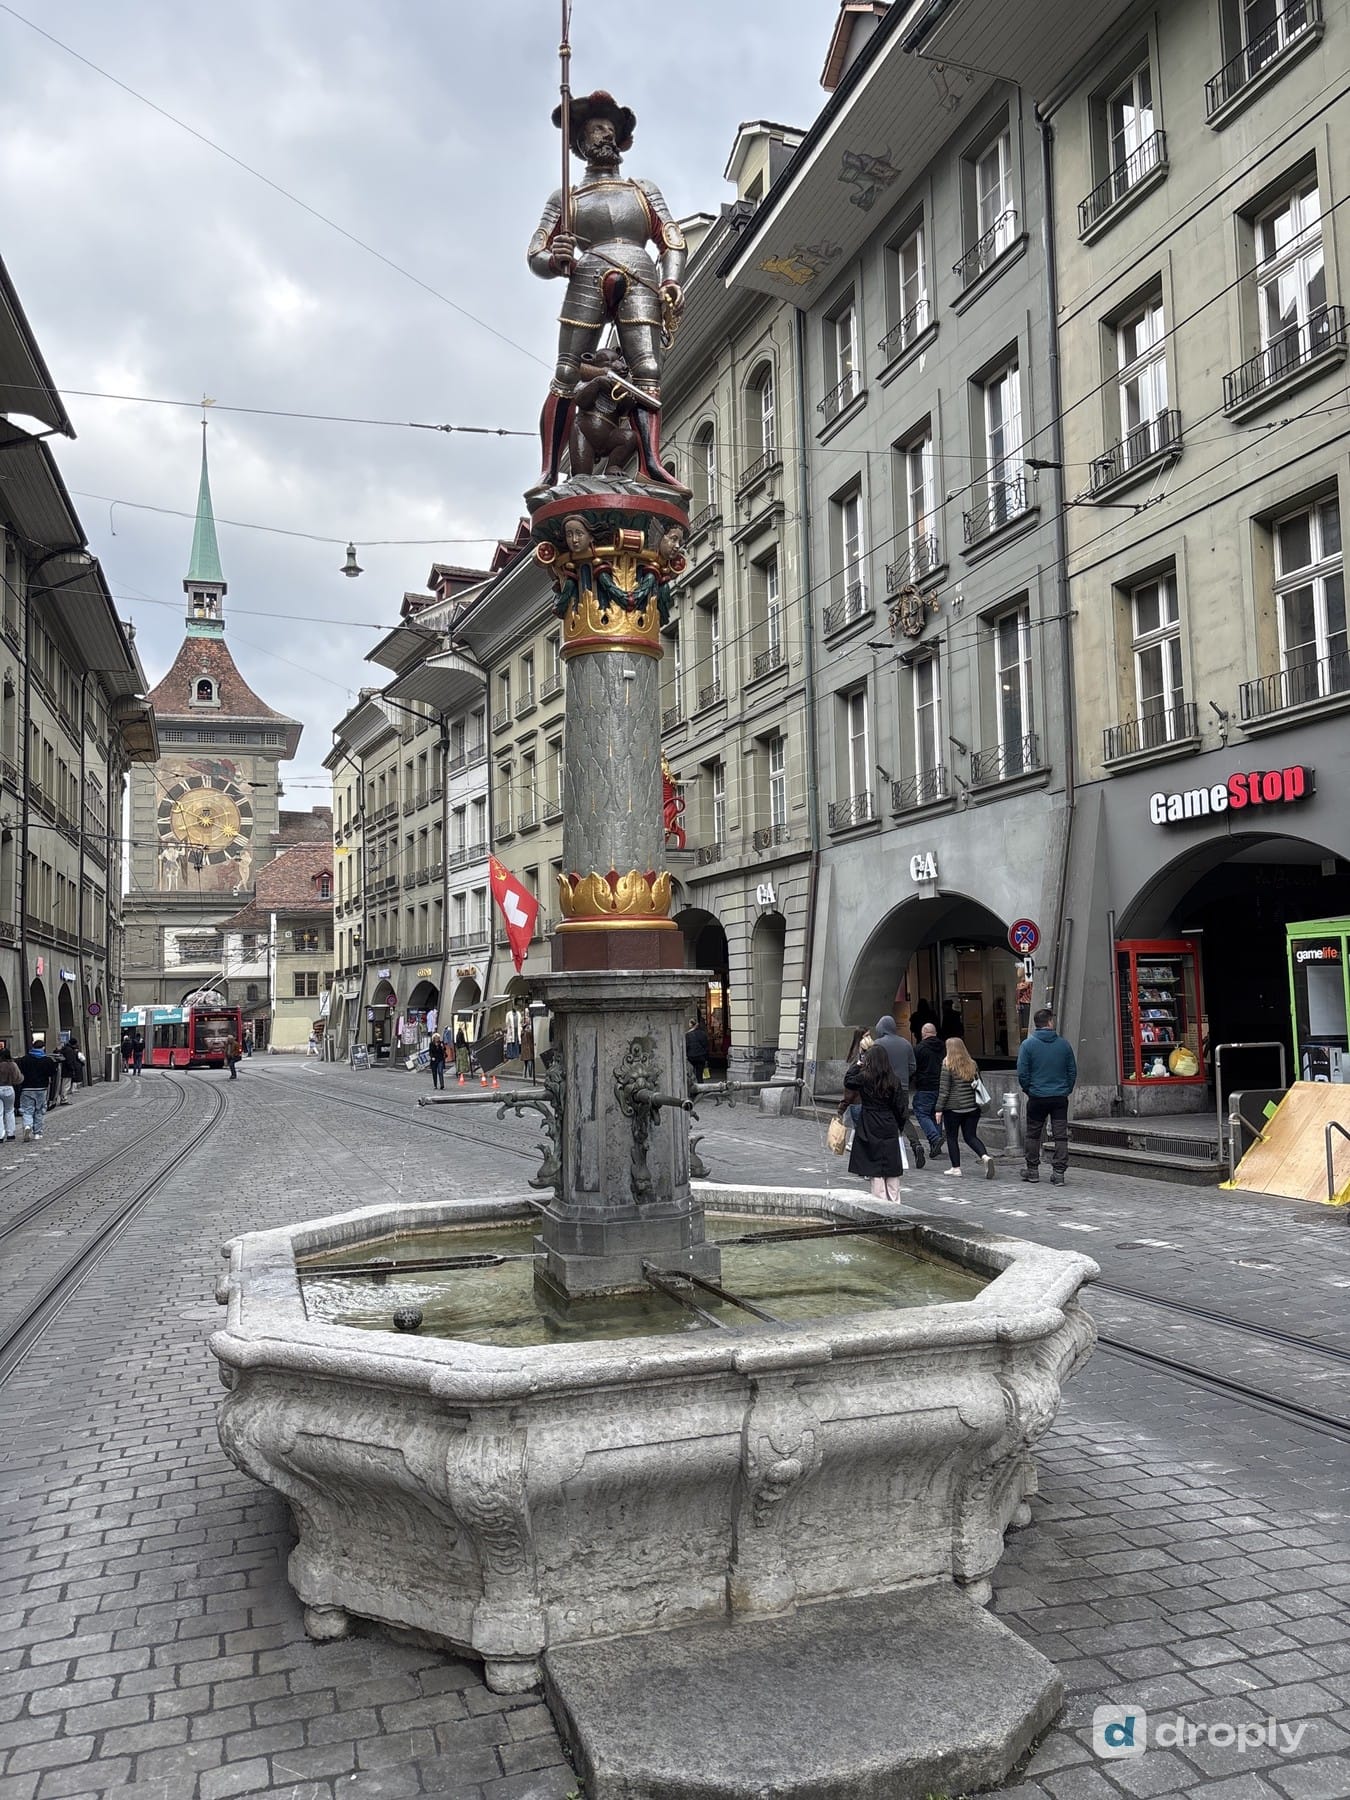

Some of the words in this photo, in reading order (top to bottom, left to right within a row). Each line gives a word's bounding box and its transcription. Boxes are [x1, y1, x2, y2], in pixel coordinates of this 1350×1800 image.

[1149, 764, 1305, 825] GameStop
[910, 851, 938, 882] C&A
[1296, 946, 1338, 963] gamelife
